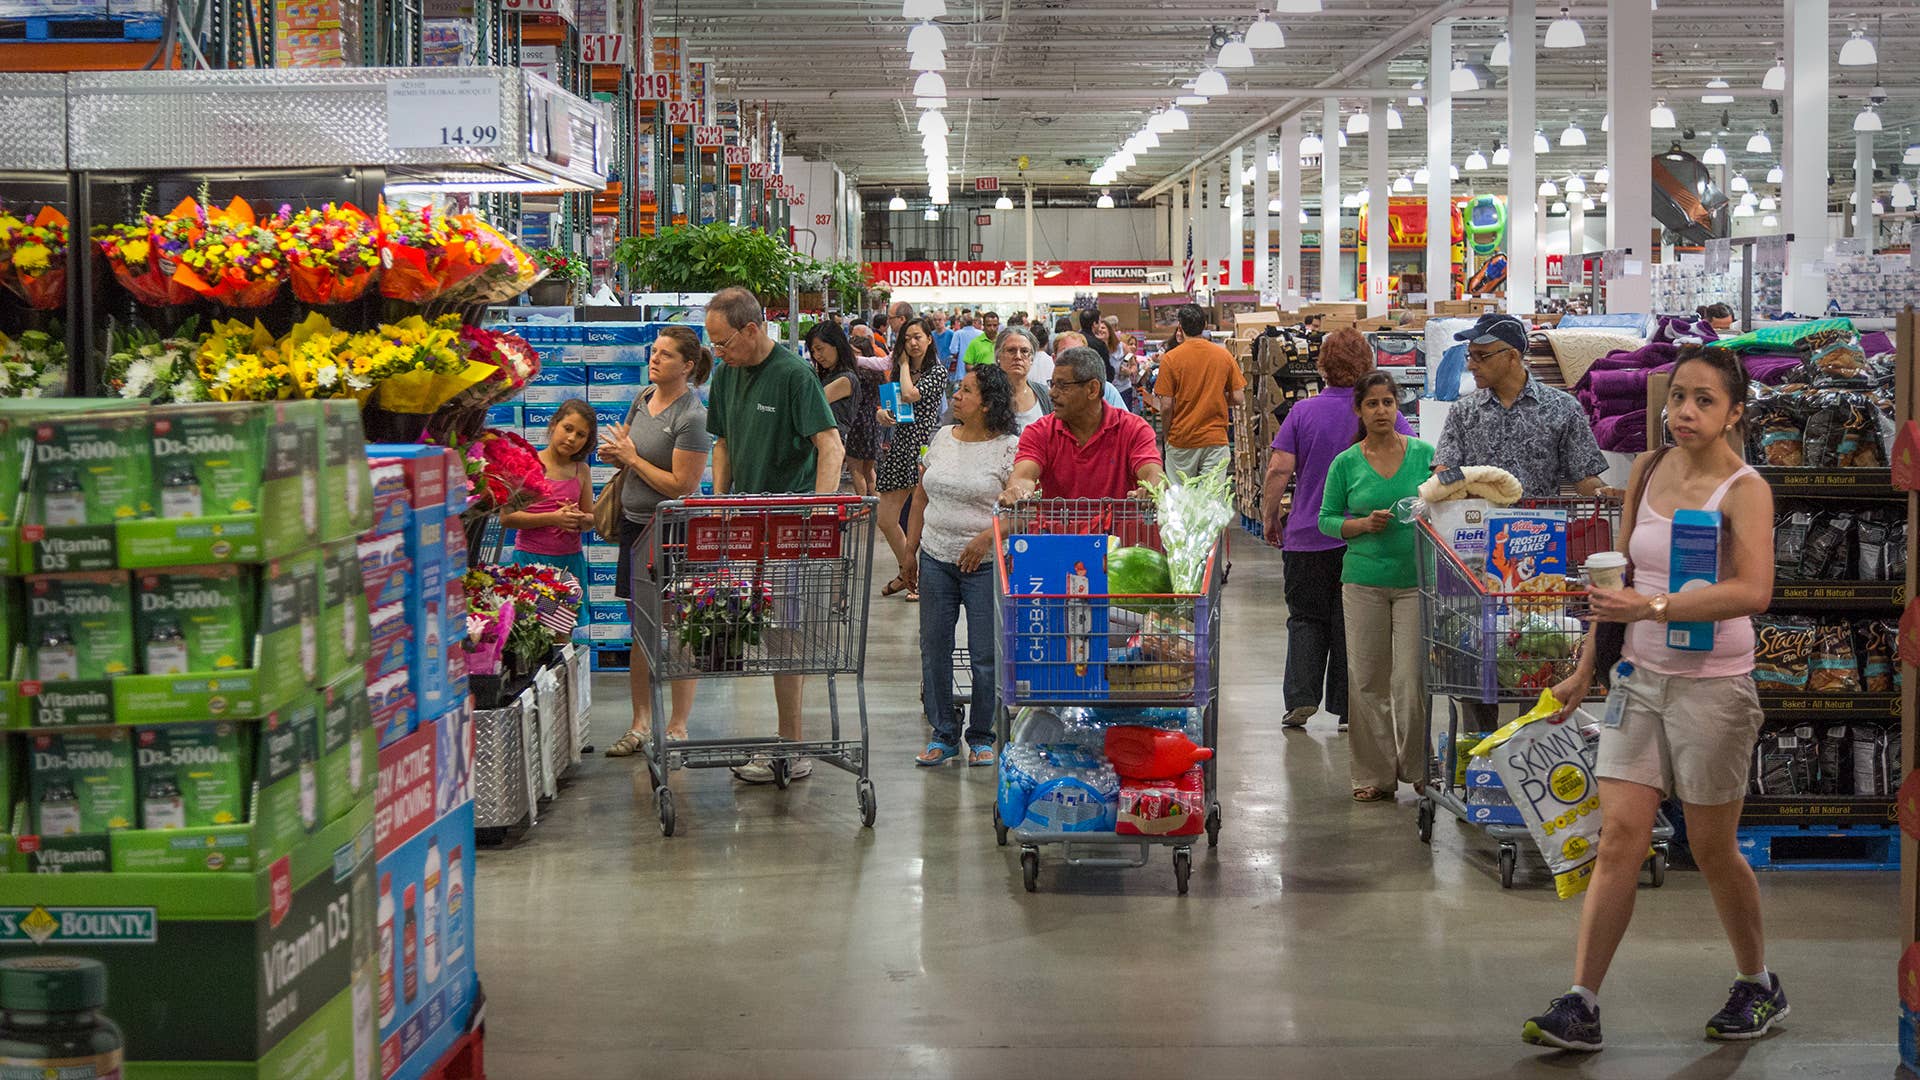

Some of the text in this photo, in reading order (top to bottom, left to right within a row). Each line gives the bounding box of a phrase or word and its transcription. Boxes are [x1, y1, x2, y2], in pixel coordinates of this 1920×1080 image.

[583, 35, 622, 61] 317
[458, 88, 492, 96] BOUQUET
[634, 75, 667, 98] 319
[669, 102, 697, 123] 321
[441, 125, 497, 145] 14.99
[696, 127, 723, 144] 323
[749, 163, 771, 177] 327
[979, 178, 995, 190] EXIT
[815, 215, 832, 225] 337
[889, 270, 933, 286] USDA
[936, 270, 996, 286] CHOICE
[1094, 268, 1146, 278] KIRKLAND
[1784, 476, 1856, 484] Baked All Natural
[1466, 511, 1480, 520] 200
[1511, 520, 1548, 534] Kellogg's
[41, 536, 110, 553] Vitamin
[1509, 533, 1551, 547] FROSTED
[1509, 542, 1546, 554] FLAKES
[41, 554, 69, 570] D3
[1783, 589, 1855, 597] Baked All Natural
[1029, 577, 1044, 663] CHOBANI
[1754, 626, 1815, 658] Stacy's
[37, 691, 107, 708] Vitamin
[1782, 700, 1853, 708] Baked All Natural
[38, 708, 65, 724] D3
[1508, 720, 1586, 782] SKINNY
[395, 743, 431, 793] ACTIVE
[374, 780, 432, 844] EEP MOVING
[1541, 796, 1600, 836] POPCO
[1779, 806, 1850, 814] Baked All Natural
[35, 847, 105, 864] Vitamin
[62, 914, 147, 936] BOUNTY
[264, 915, 326, 997] Vitamin
[328, 893, 349, 950] D3
